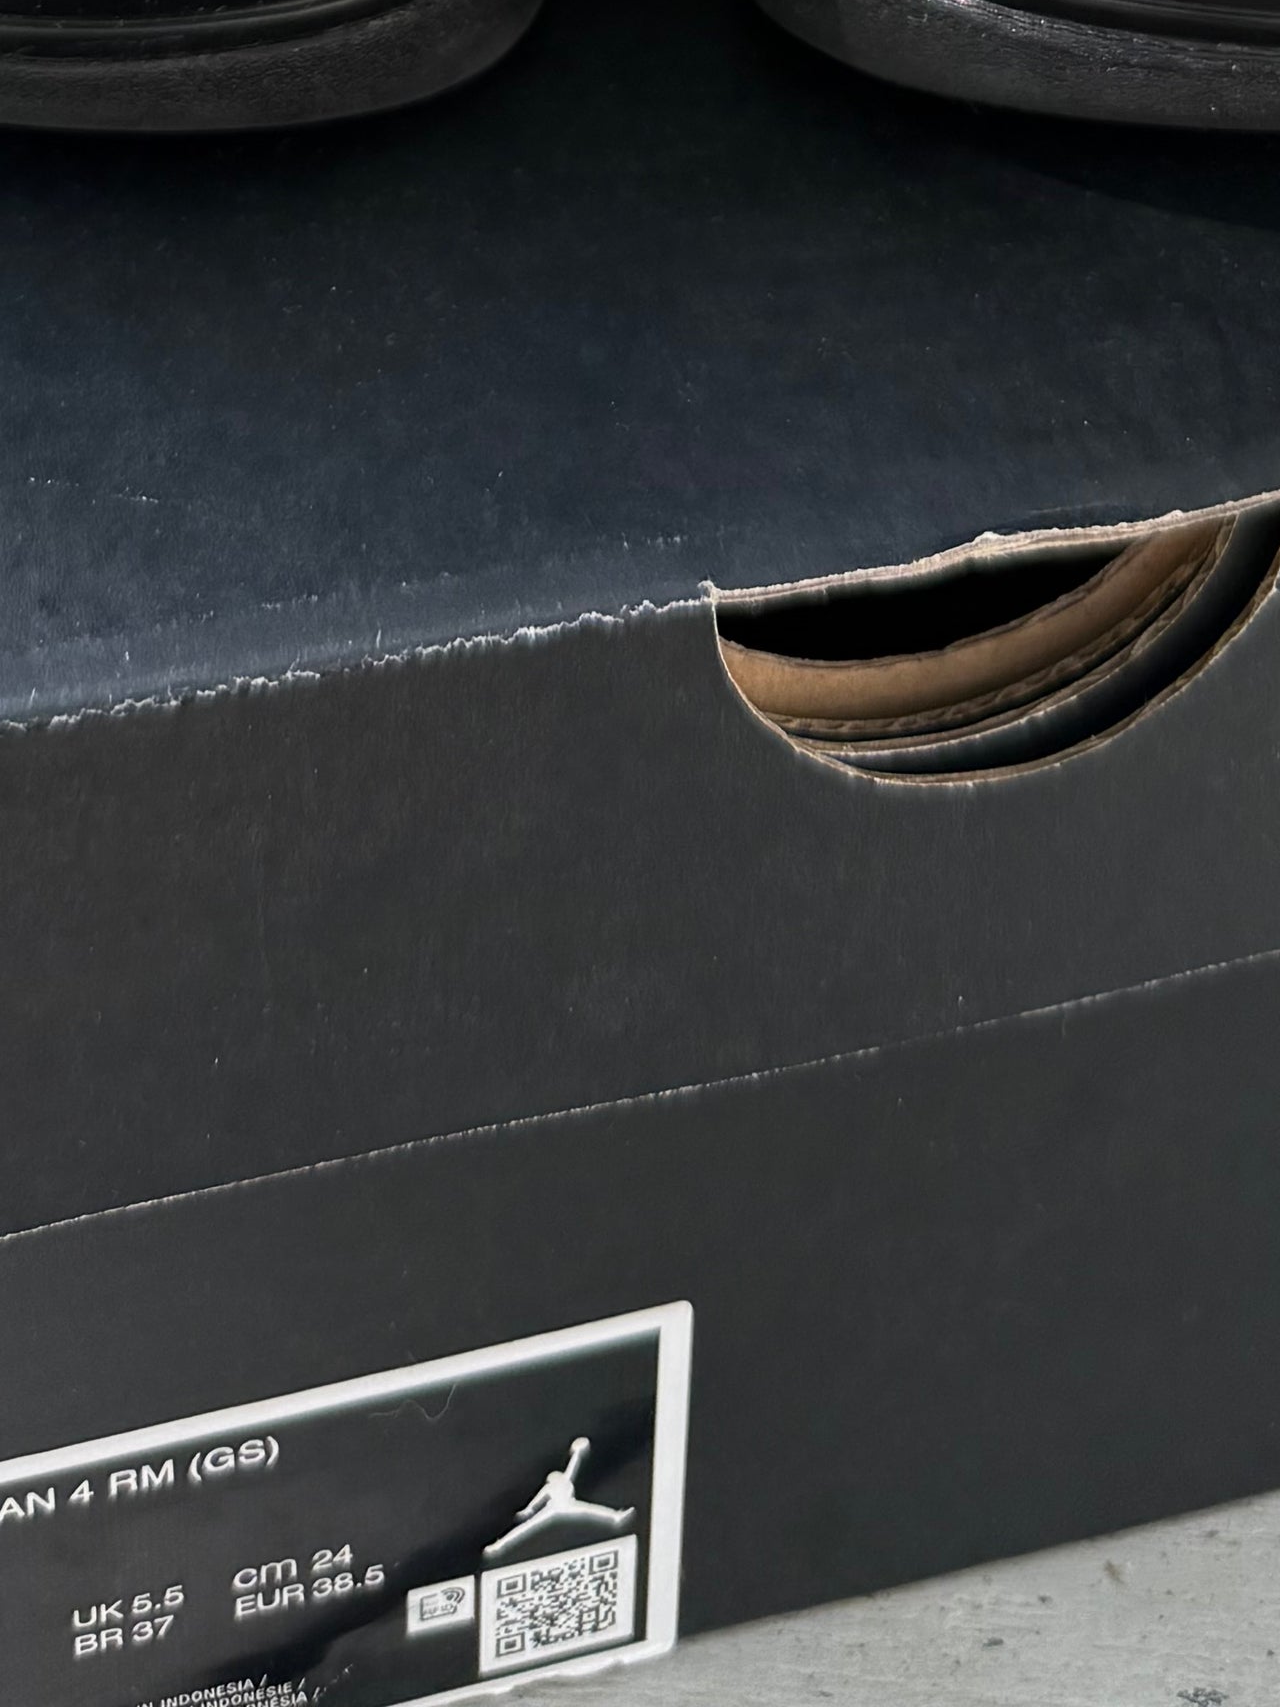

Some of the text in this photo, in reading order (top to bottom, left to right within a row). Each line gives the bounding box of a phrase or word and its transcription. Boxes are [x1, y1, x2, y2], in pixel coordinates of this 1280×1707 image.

[69, 1479, 94, 1504] 4
[109, 1459, 174, 1497] RM
[187, 1436, 279, 1482] (GS)
[232, 1544, 353, 1588] cm 24
[72, 1585, 185, 1629] UK 5.5
[235, 1564, 385, 1618] EUR 38.5
[74, 1615, 174, 1657] BR 37
